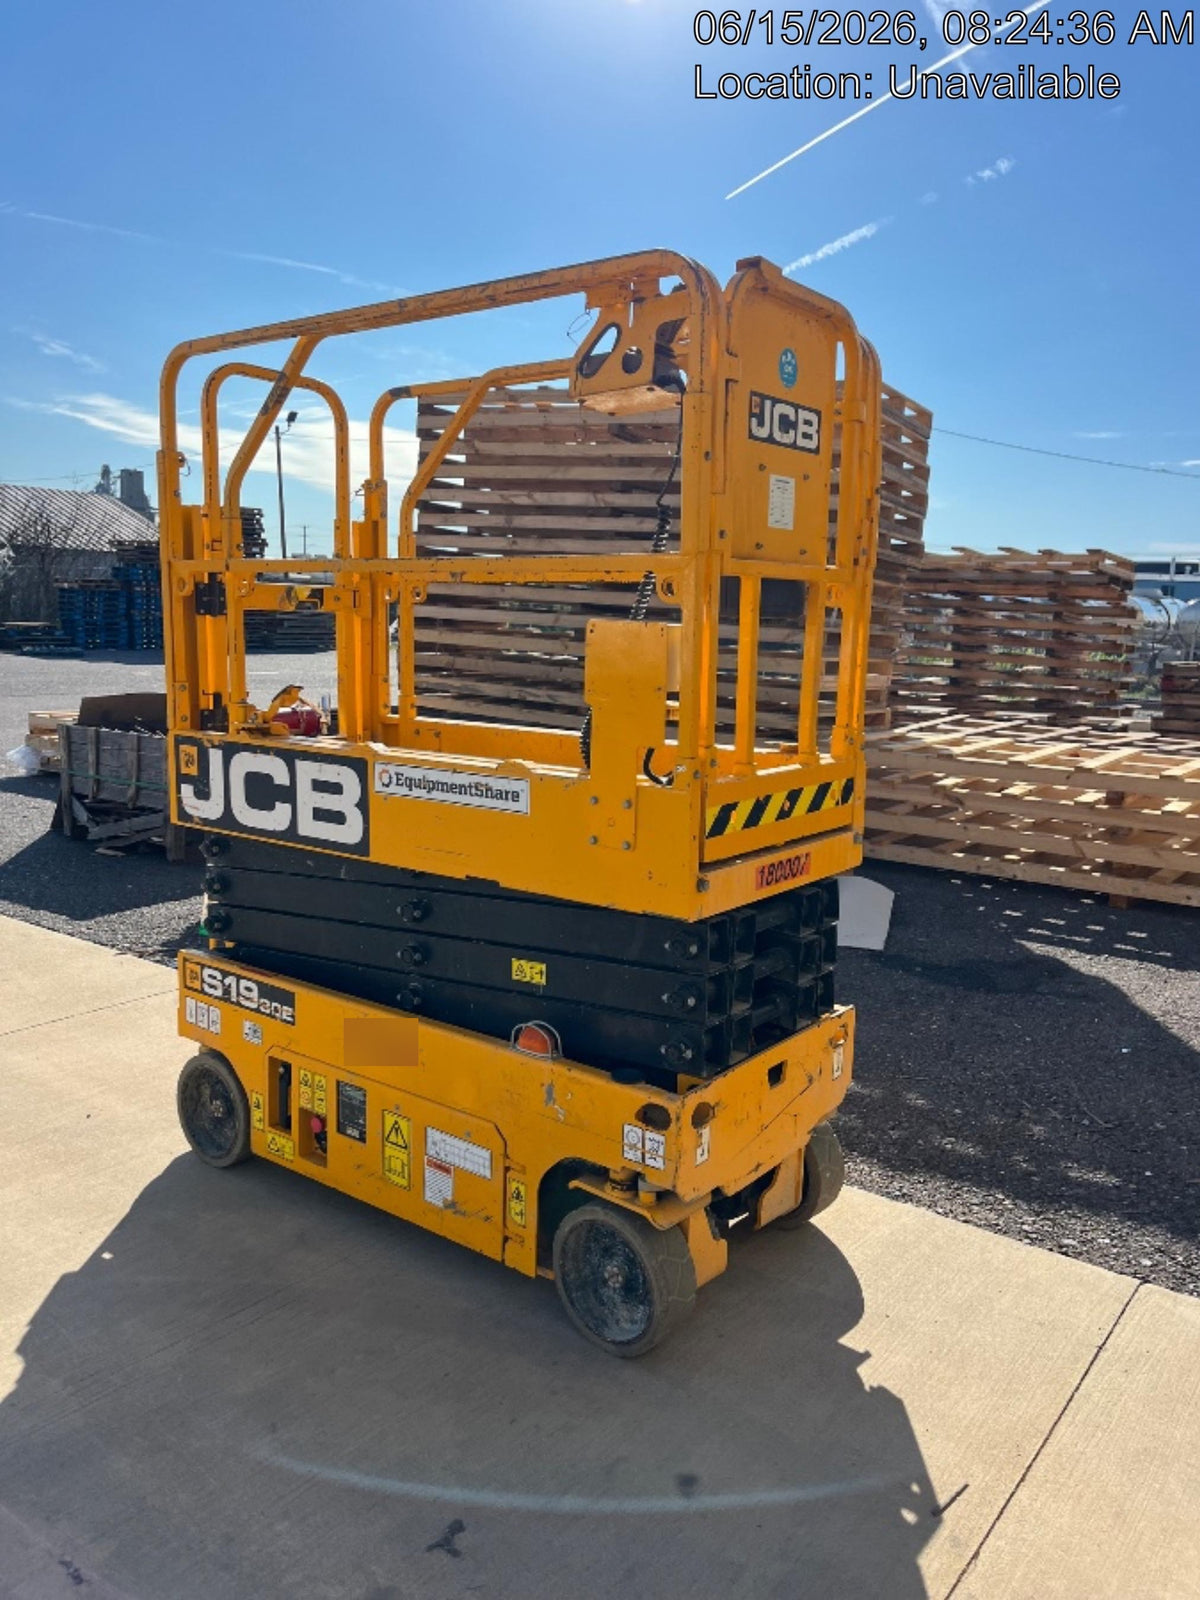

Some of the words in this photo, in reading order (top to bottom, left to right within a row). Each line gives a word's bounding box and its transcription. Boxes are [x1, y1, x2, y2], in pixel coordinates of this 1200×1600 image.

[751, 398, 820, 450] JCB
[180, 747, 364, 845] JCB
[394, 771, 521, 803] EquipmentShare
